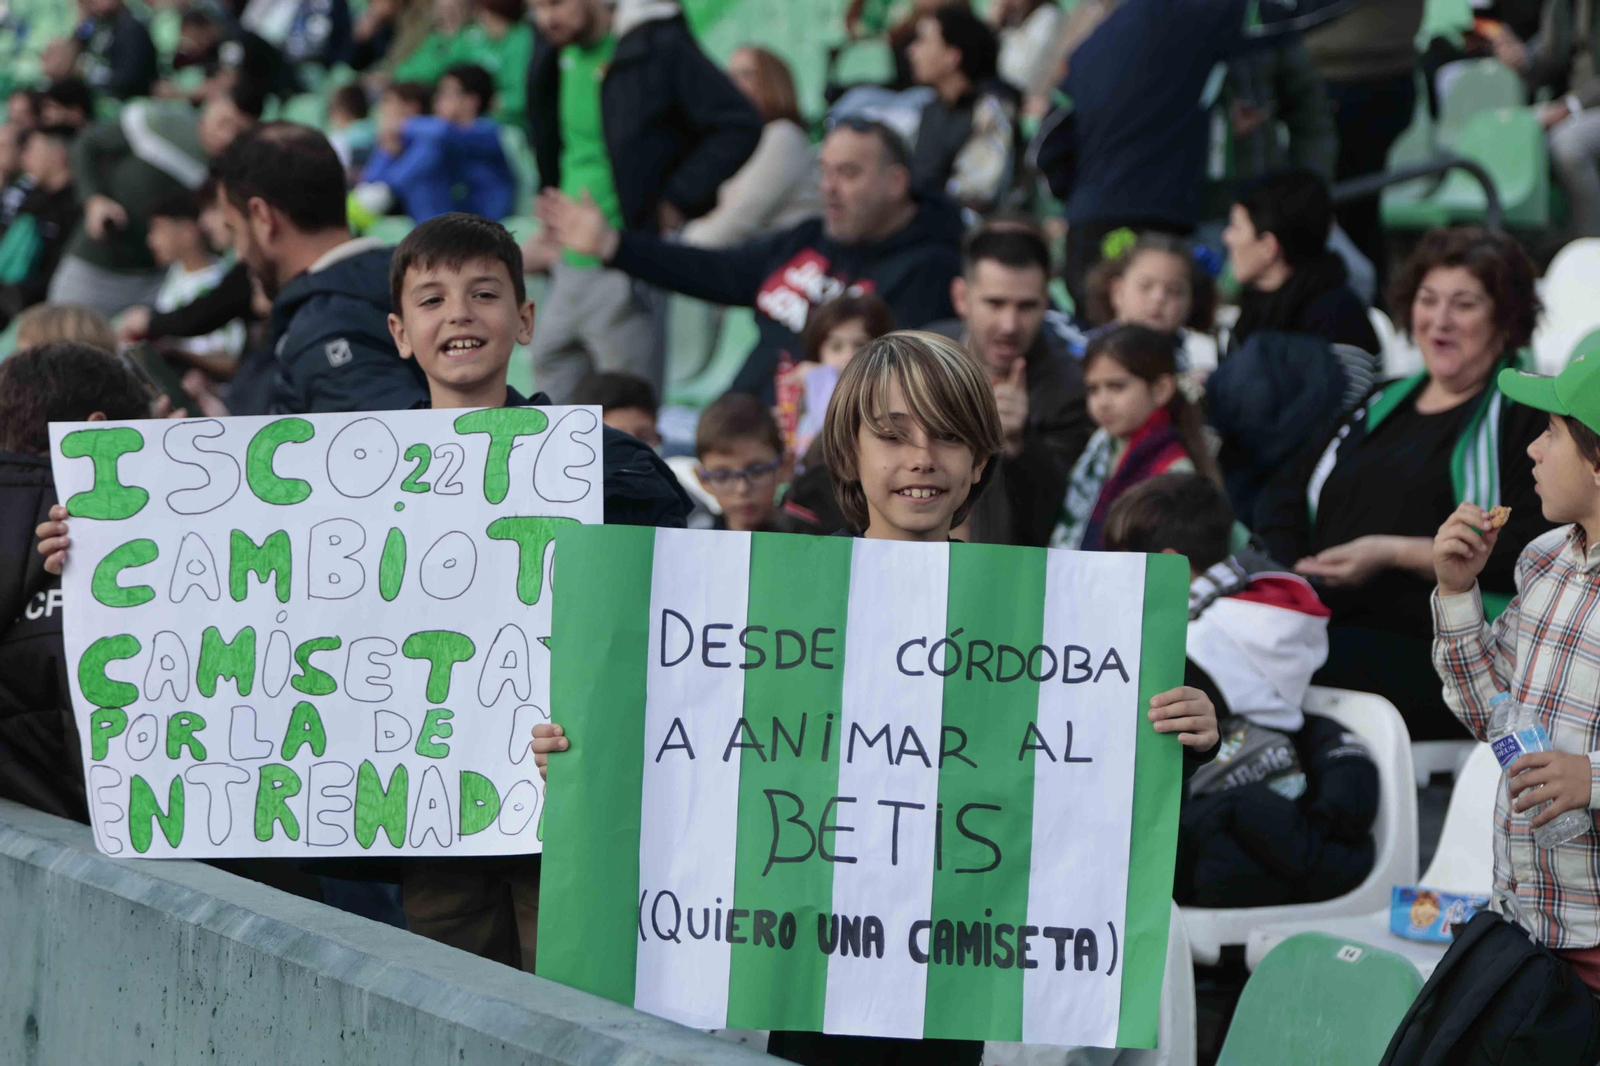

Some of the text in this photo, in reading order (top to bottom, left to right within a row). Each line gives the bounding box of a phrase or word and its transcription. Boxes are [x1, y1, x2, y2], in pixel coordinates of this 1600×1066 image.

[60, 407, 596, 520] ISCO 22 TE
[486, 515, 582, 606] T
[660, 608, 1130, 684] DESDE CÓRDOBA
[90, 707, 207, 761] POR
[229, 701, 327, 761] LA
[375, 708, 455, 759] DE
[655, 717, 696, 763] A
[1018, 720, 1093, 763] AL
[90, 759, 543, 855] ENTRENADO
[816, 914, 885, 958] UNA
